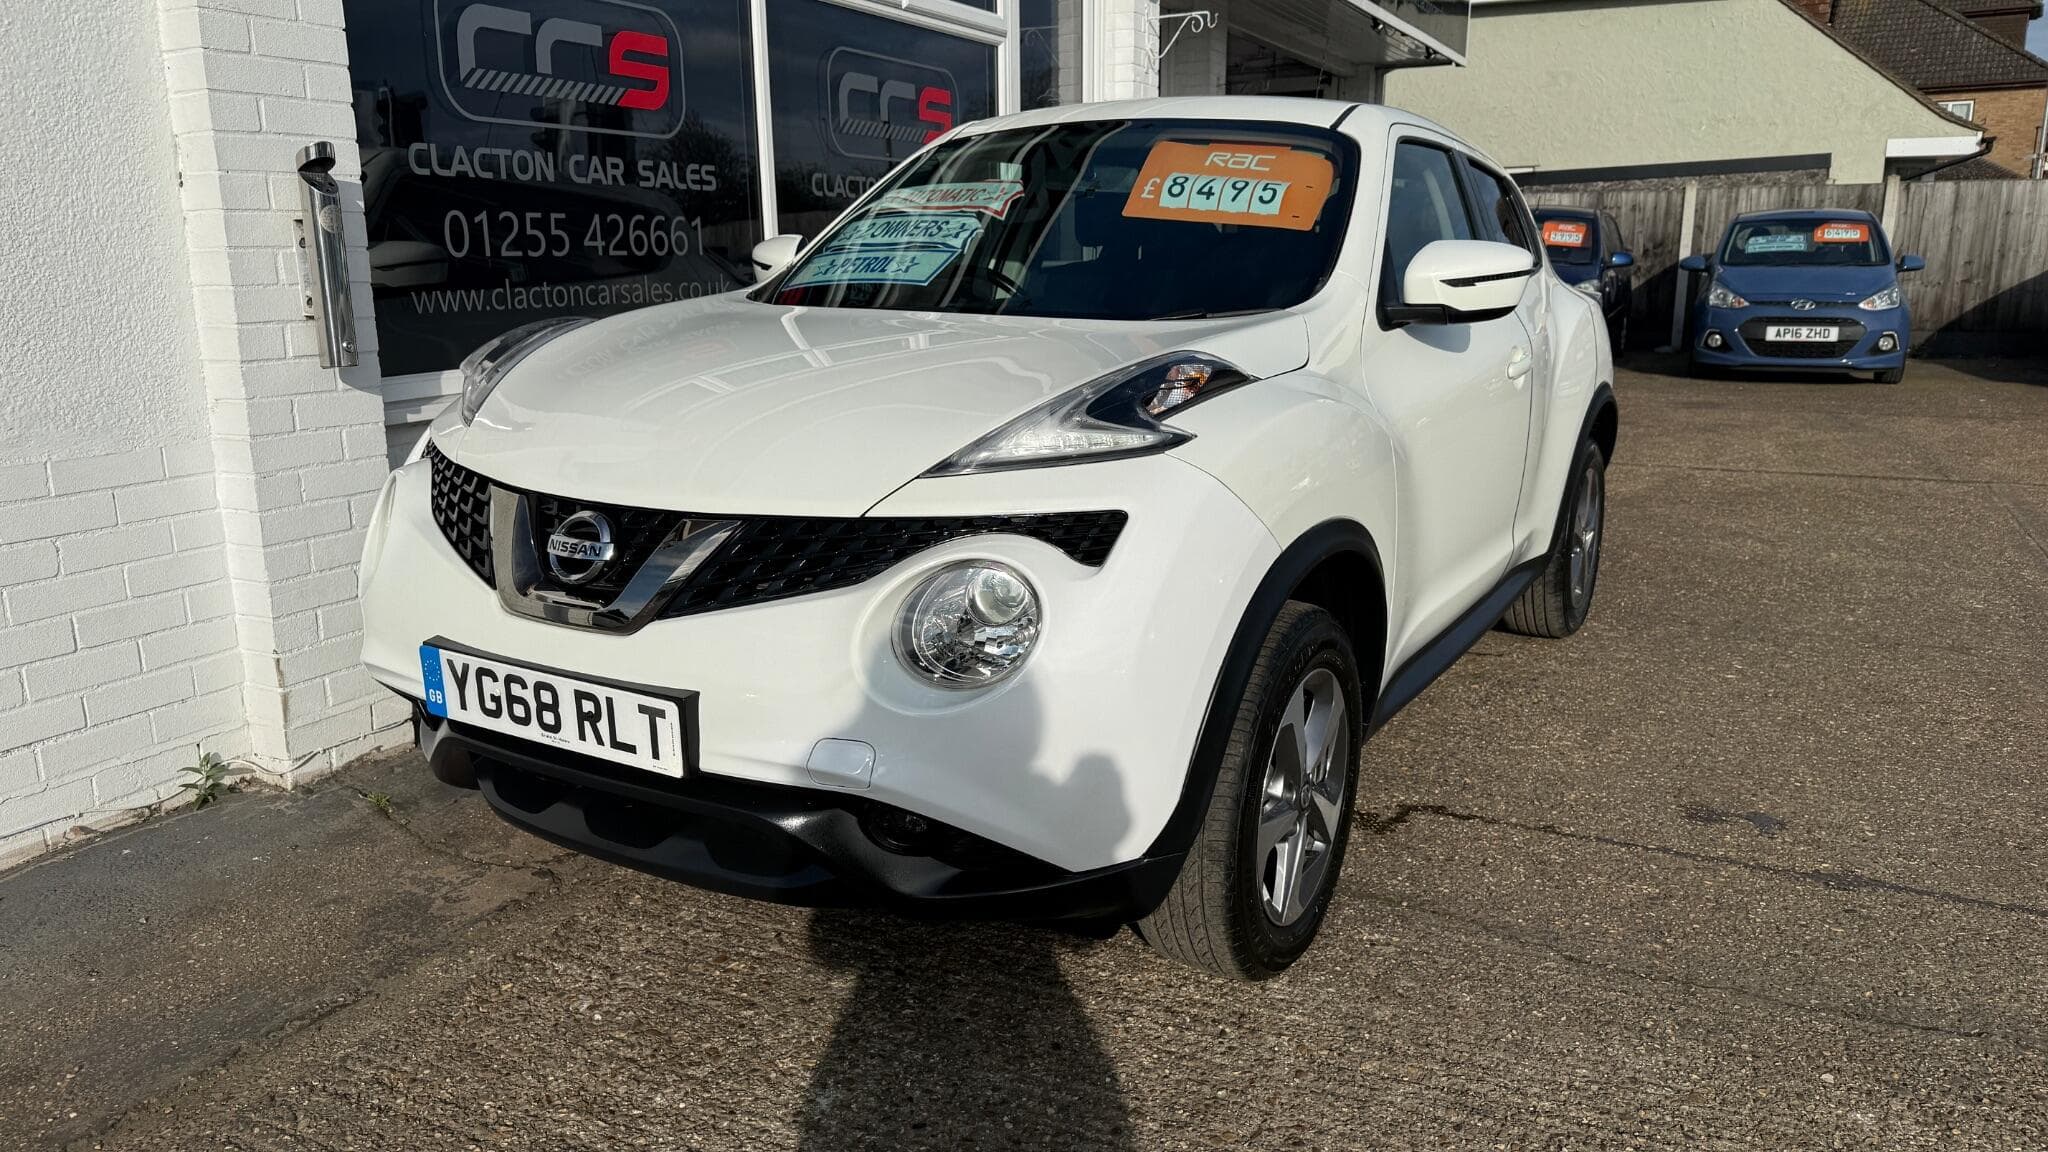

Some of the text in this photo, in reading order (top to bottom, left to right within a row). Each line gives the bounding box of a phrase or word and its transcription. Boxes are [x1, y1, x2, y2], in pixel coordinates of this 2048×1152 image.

[457, 3, 669, 110] CCS
[408, 142, 717, 192] CLACTON CAR SALES
[812, 172, 880, 199] CLACT
[444, 209, 704, 258] 01255 426661
[871, 220, 950, 239] OWNERS
[833, 255, 896, 275] PETROL
[1775, 327, 1831, 339] AP16 ZHD
[550, 538, 602, 558] NISSAN
[429, 688, 443, 704] GB
[447, 658, 562, 735] YG68
[573, 688, 666, 761] RLT
